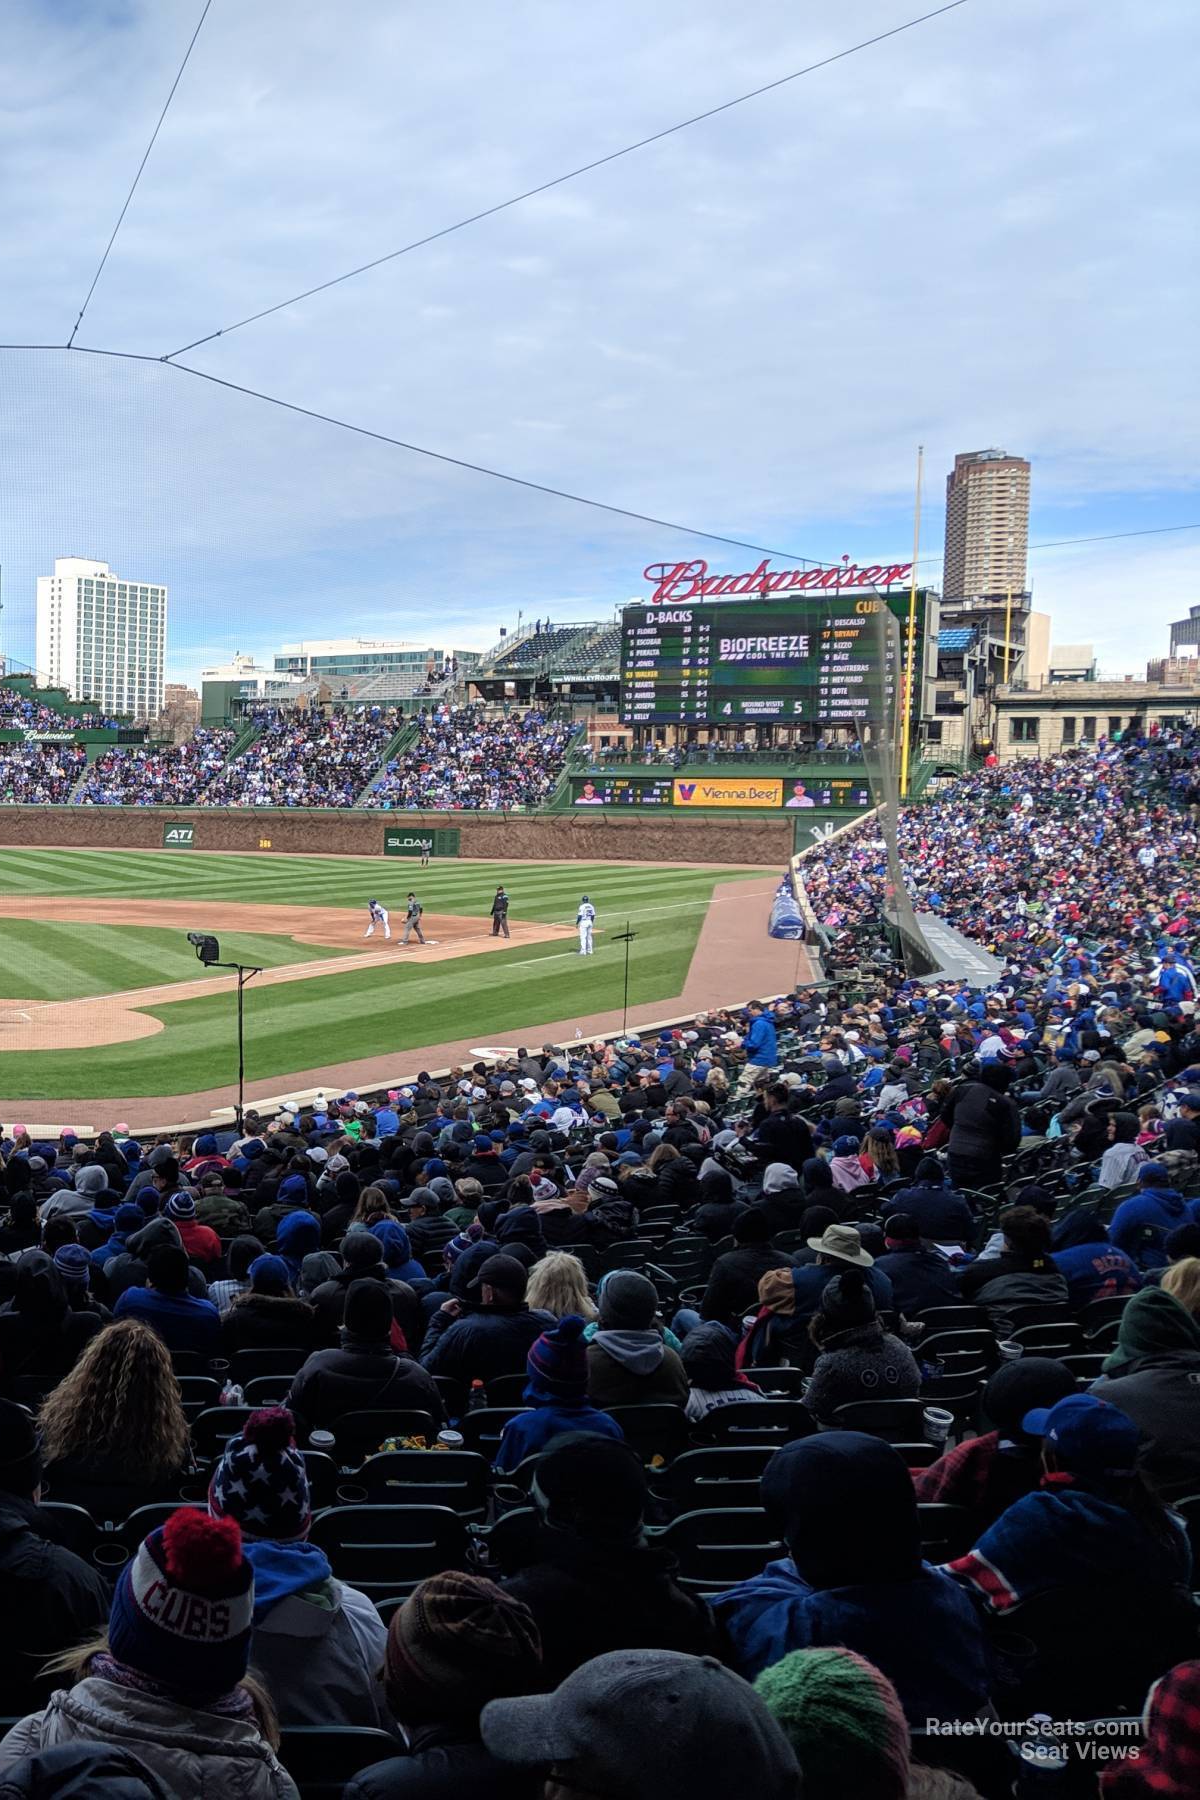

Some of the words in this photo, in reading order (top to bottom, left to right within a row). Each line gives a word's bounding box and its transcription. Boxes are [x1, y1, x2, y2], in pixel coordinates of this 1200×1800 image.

[643, 555, 913, 604] Budweiser
[646, 610, 693, 624] D-BACKS
[834, 618, 865, 626] DESCALSO
[834, 630, 859, 638] BRYANT
[722, 702, 732, 715] 4
[793, 701, 803, 714] 5
[24, 730, 75, 741] Budweiser
[702, 787, 746, 799] Vienna
[749, 787, 780, 803] Beef
[166, 829, 193, 840] ATI
[142, 1580, 230, 1639] CUBS
